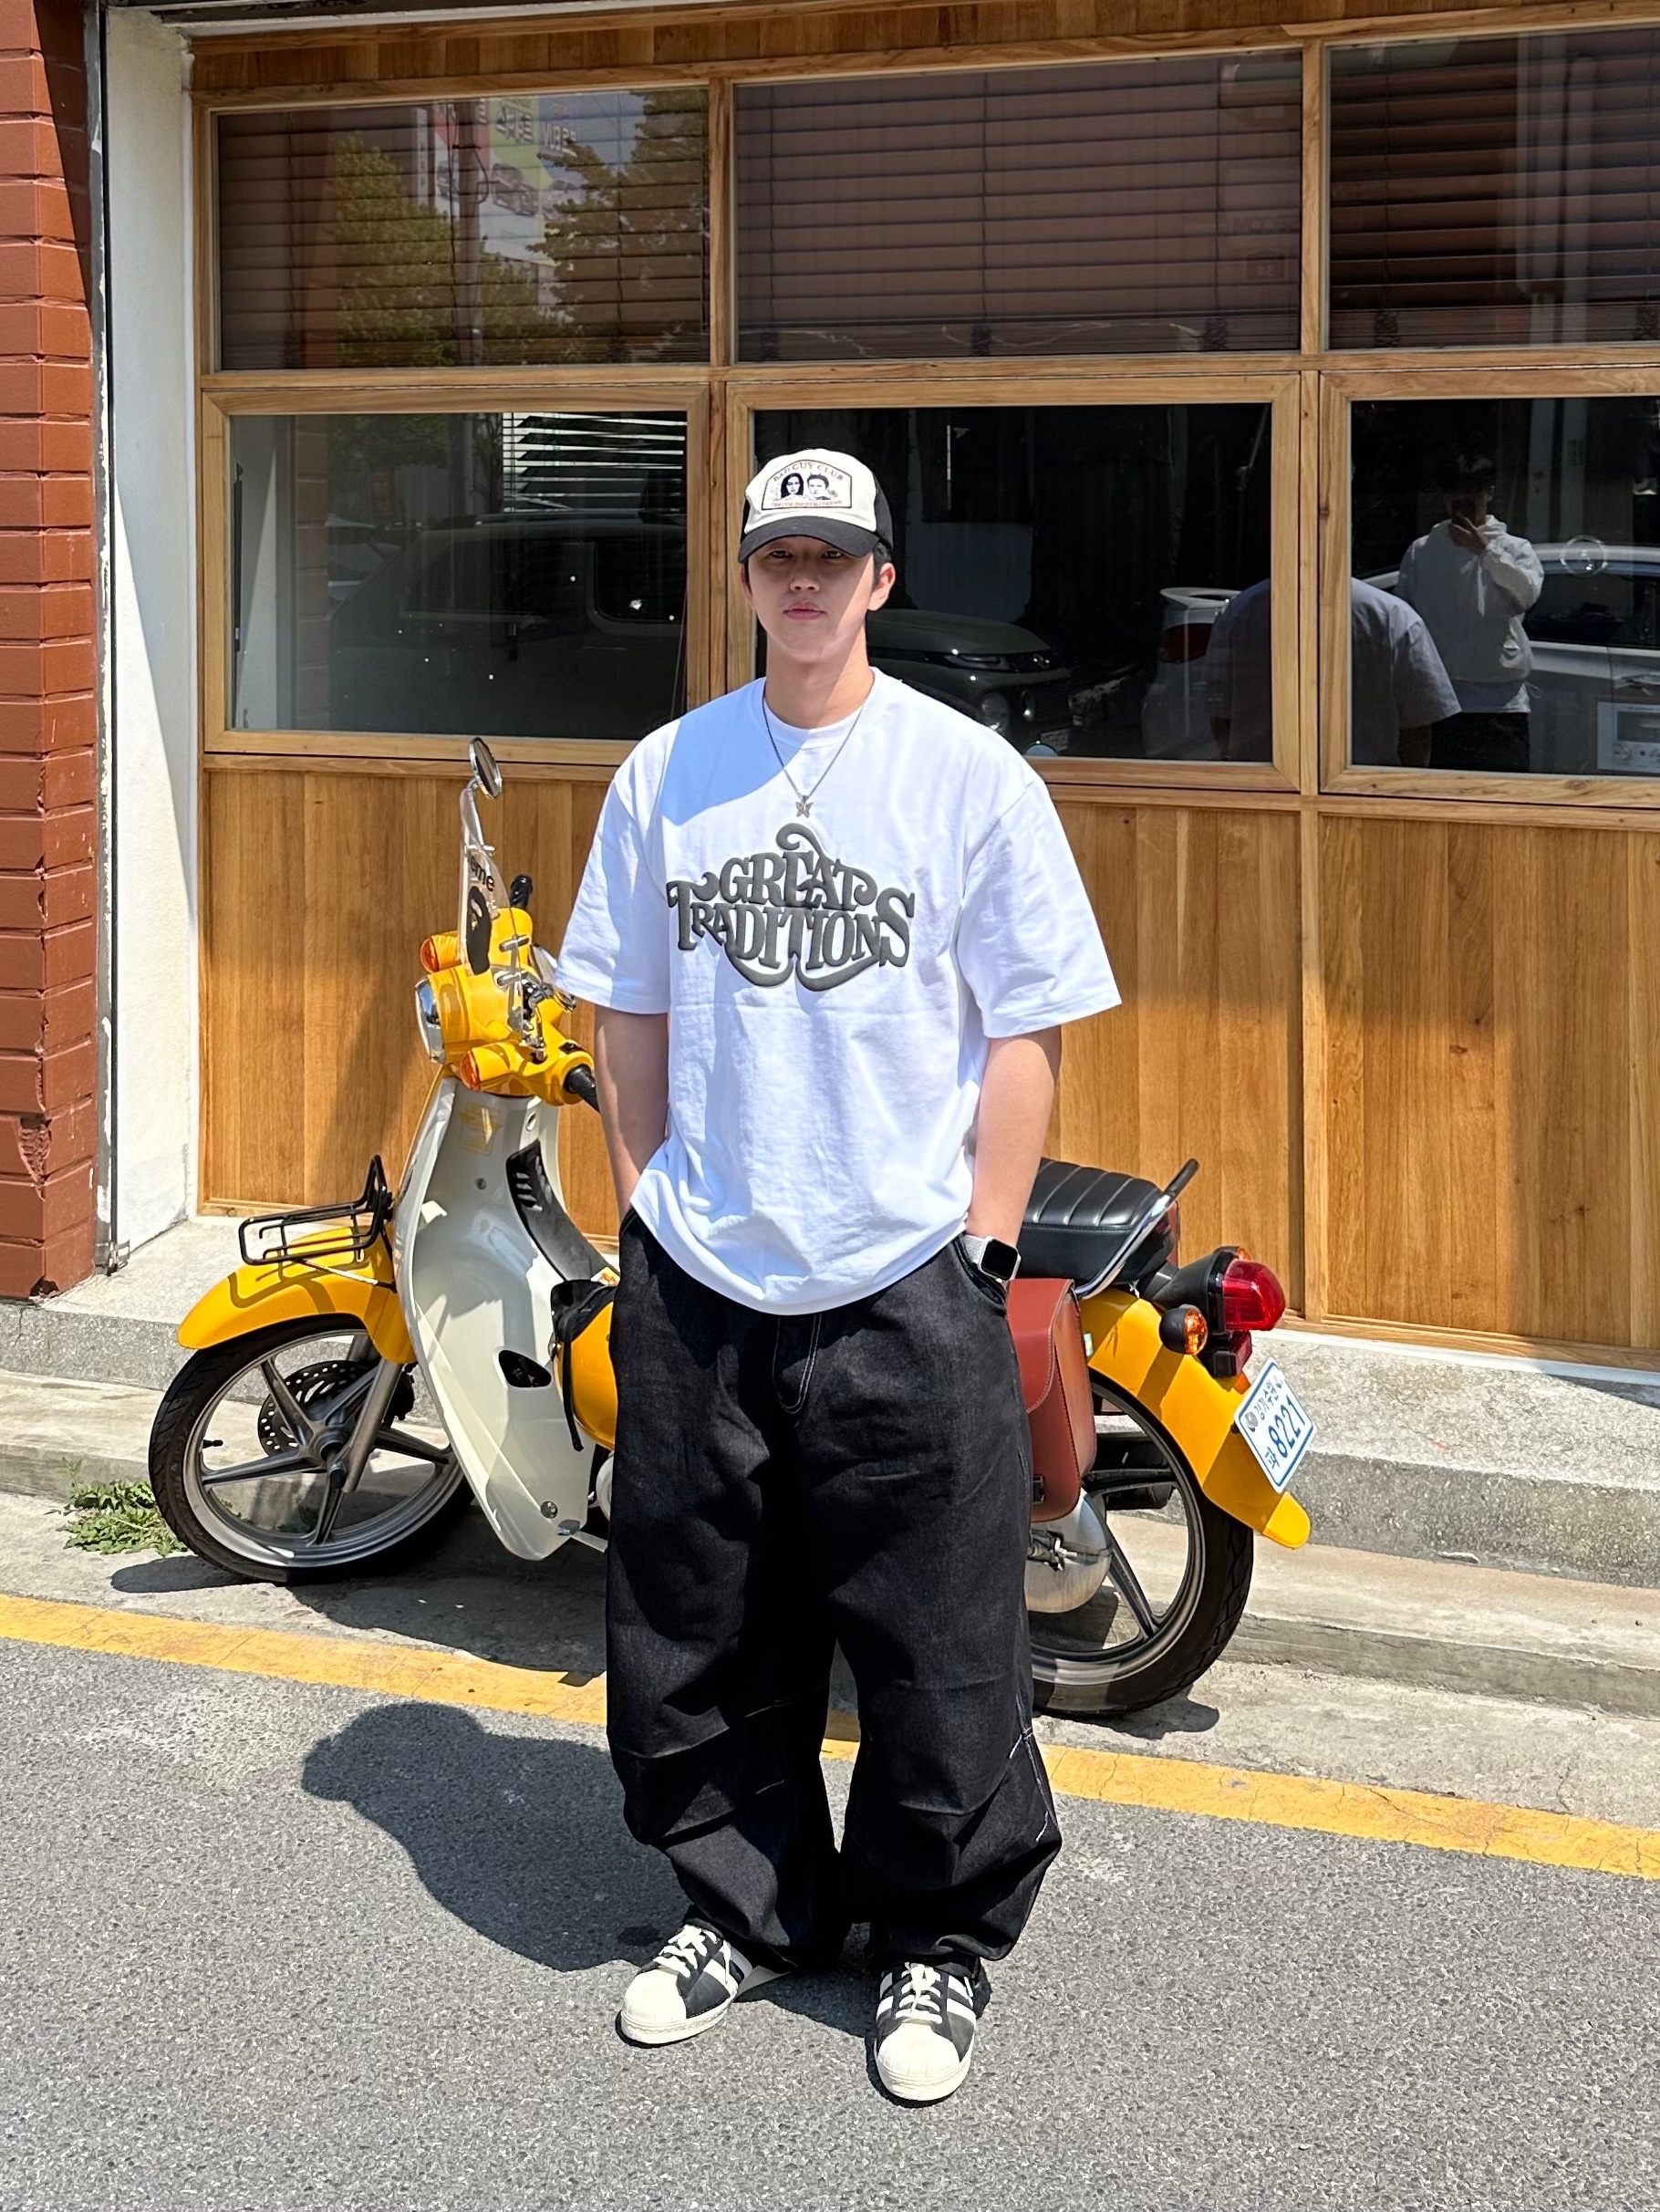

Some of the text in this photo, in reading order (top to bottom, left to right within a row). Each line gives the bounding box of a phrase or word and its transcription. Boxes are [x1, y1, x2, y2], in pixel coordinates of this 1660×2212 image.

[792, 462, 814, 471] GUY
[817, 464, 844, 481] CLUB
[720, 823, 877, 911] GREAT
[666, 871, 916, 992] TRADITIONS
[1268, 1394, 1306, 1459] 8221
